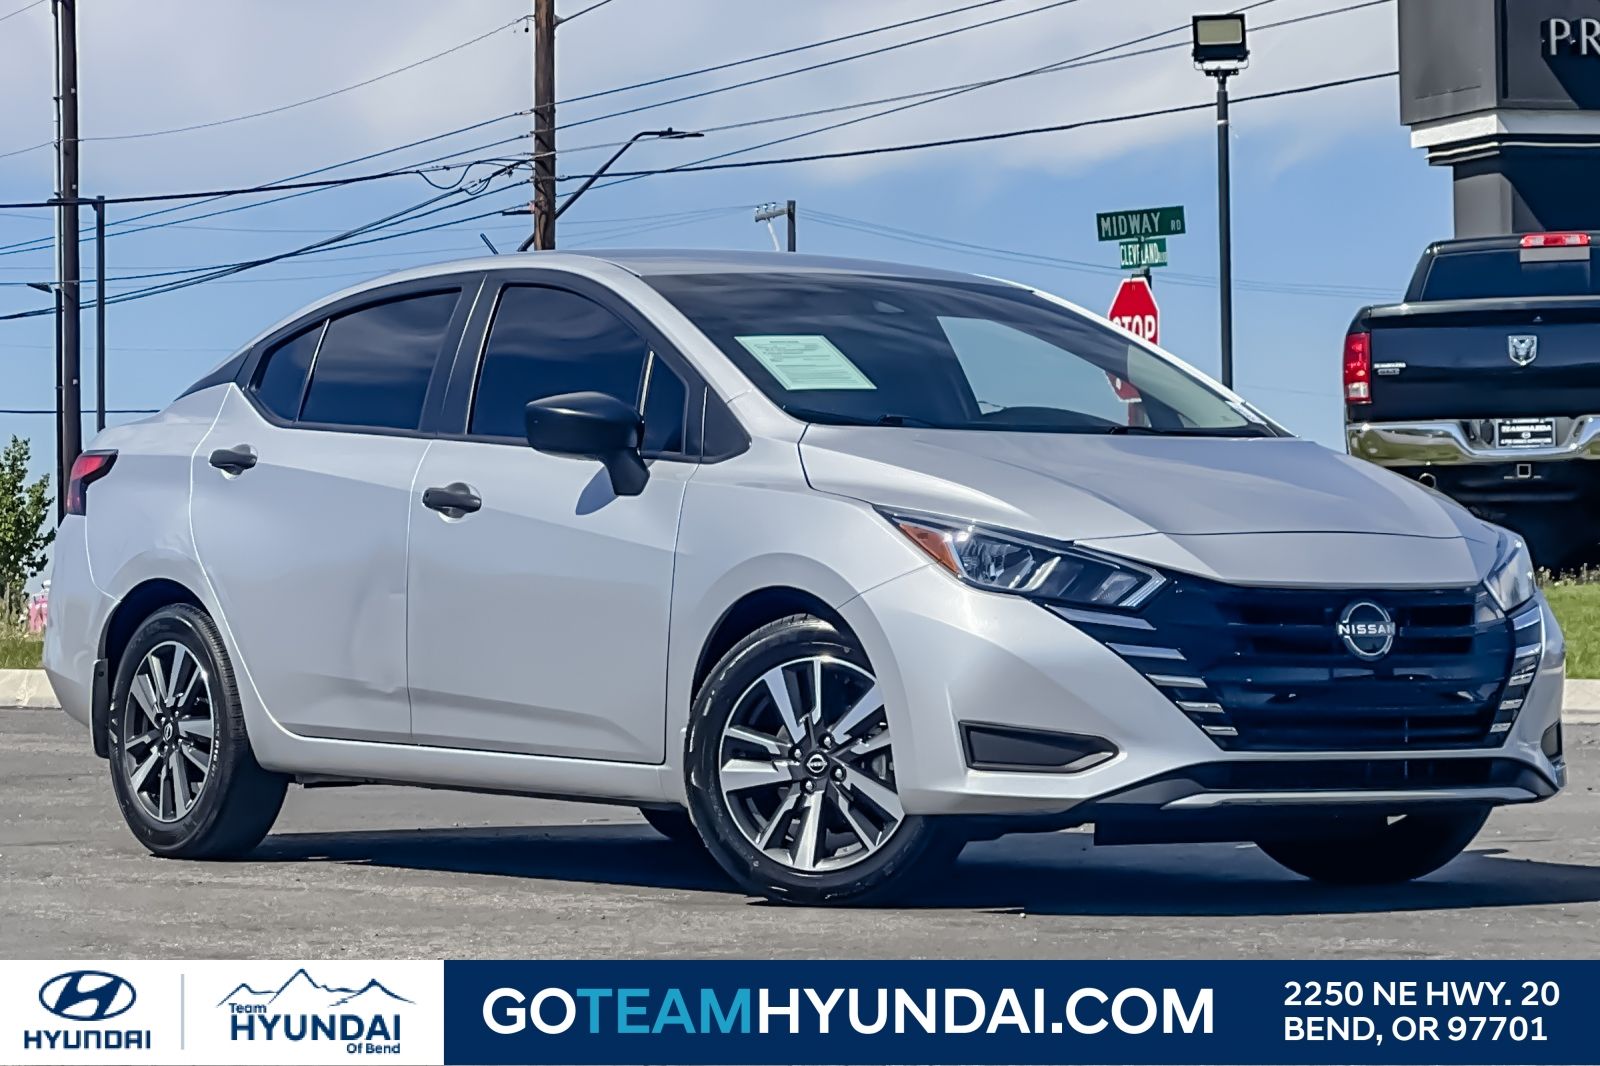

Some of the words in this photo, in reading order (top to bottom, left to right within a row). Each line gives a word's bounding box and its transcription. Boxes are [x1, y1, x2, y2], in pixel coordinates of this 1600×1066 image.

[1100, 211, 1161, 238] MIDWAY
[1170, 219, 1182, 231] RD
[1120, 242, 1159, 266] CLEVELAND
[1112, 314, 1156, 341] TOP
[1338, 624, 1395, 635] NISSAN
